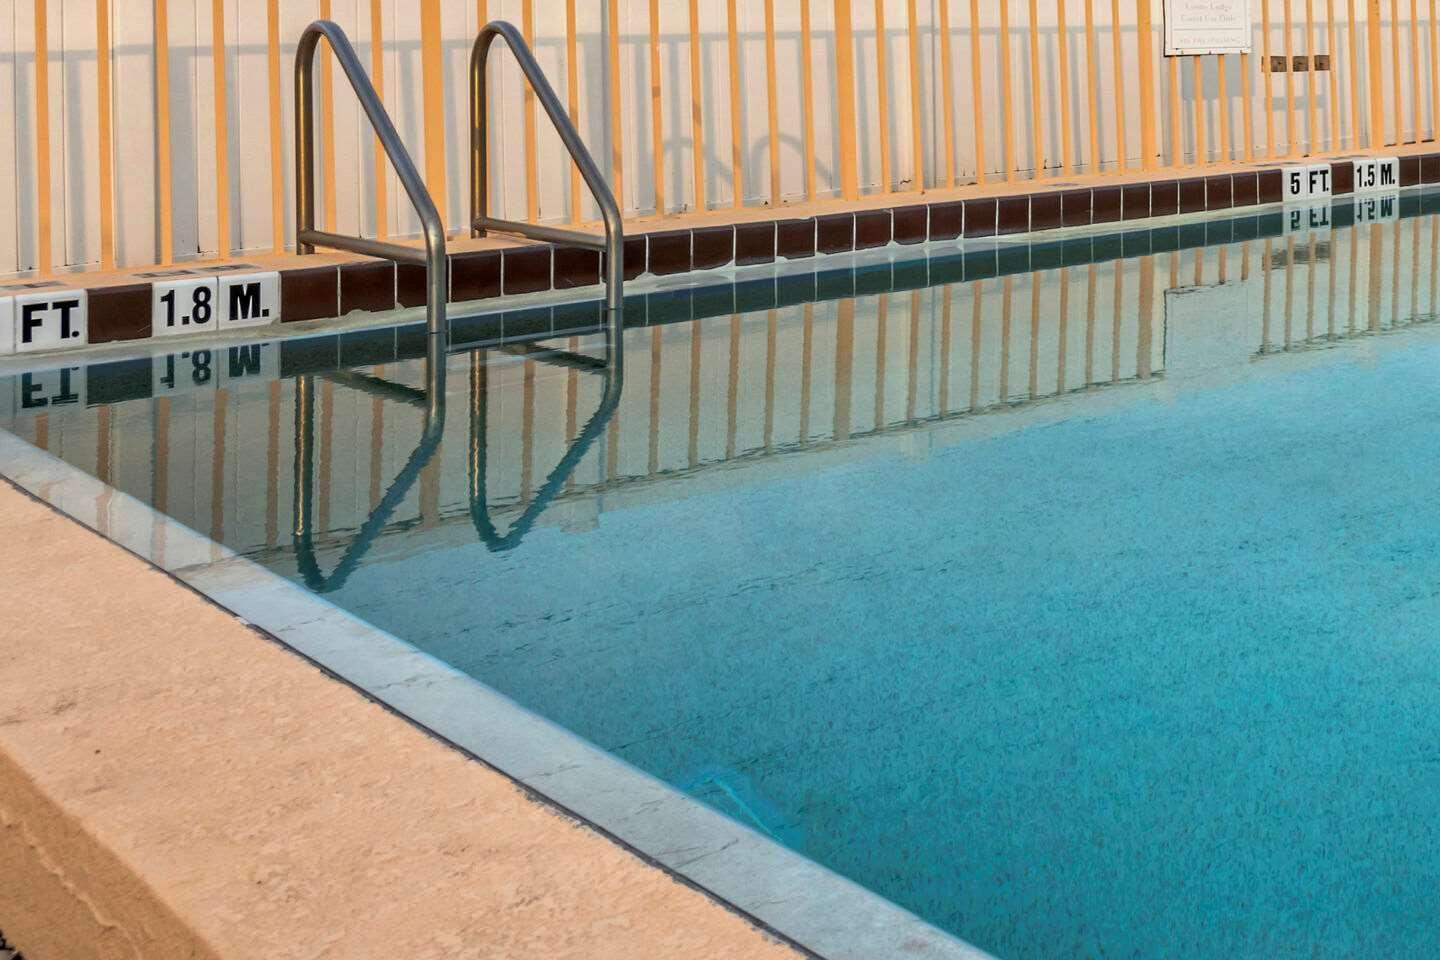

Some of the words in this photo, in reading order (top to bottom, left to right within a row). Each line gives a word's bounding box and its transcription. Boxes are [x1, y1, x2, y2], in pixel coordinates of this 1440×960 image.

[1290, 172, 1300, 195] 5
[1309, 169, 1329, 193] FT.
[1356, 164, 1375, 187] 1.5
[1380, 163, 1395, 186] M.
[22, 299, 80, 344] FT.
[160, 286, 212, 327] 1.8
[229, 282, 270, 321] M.
